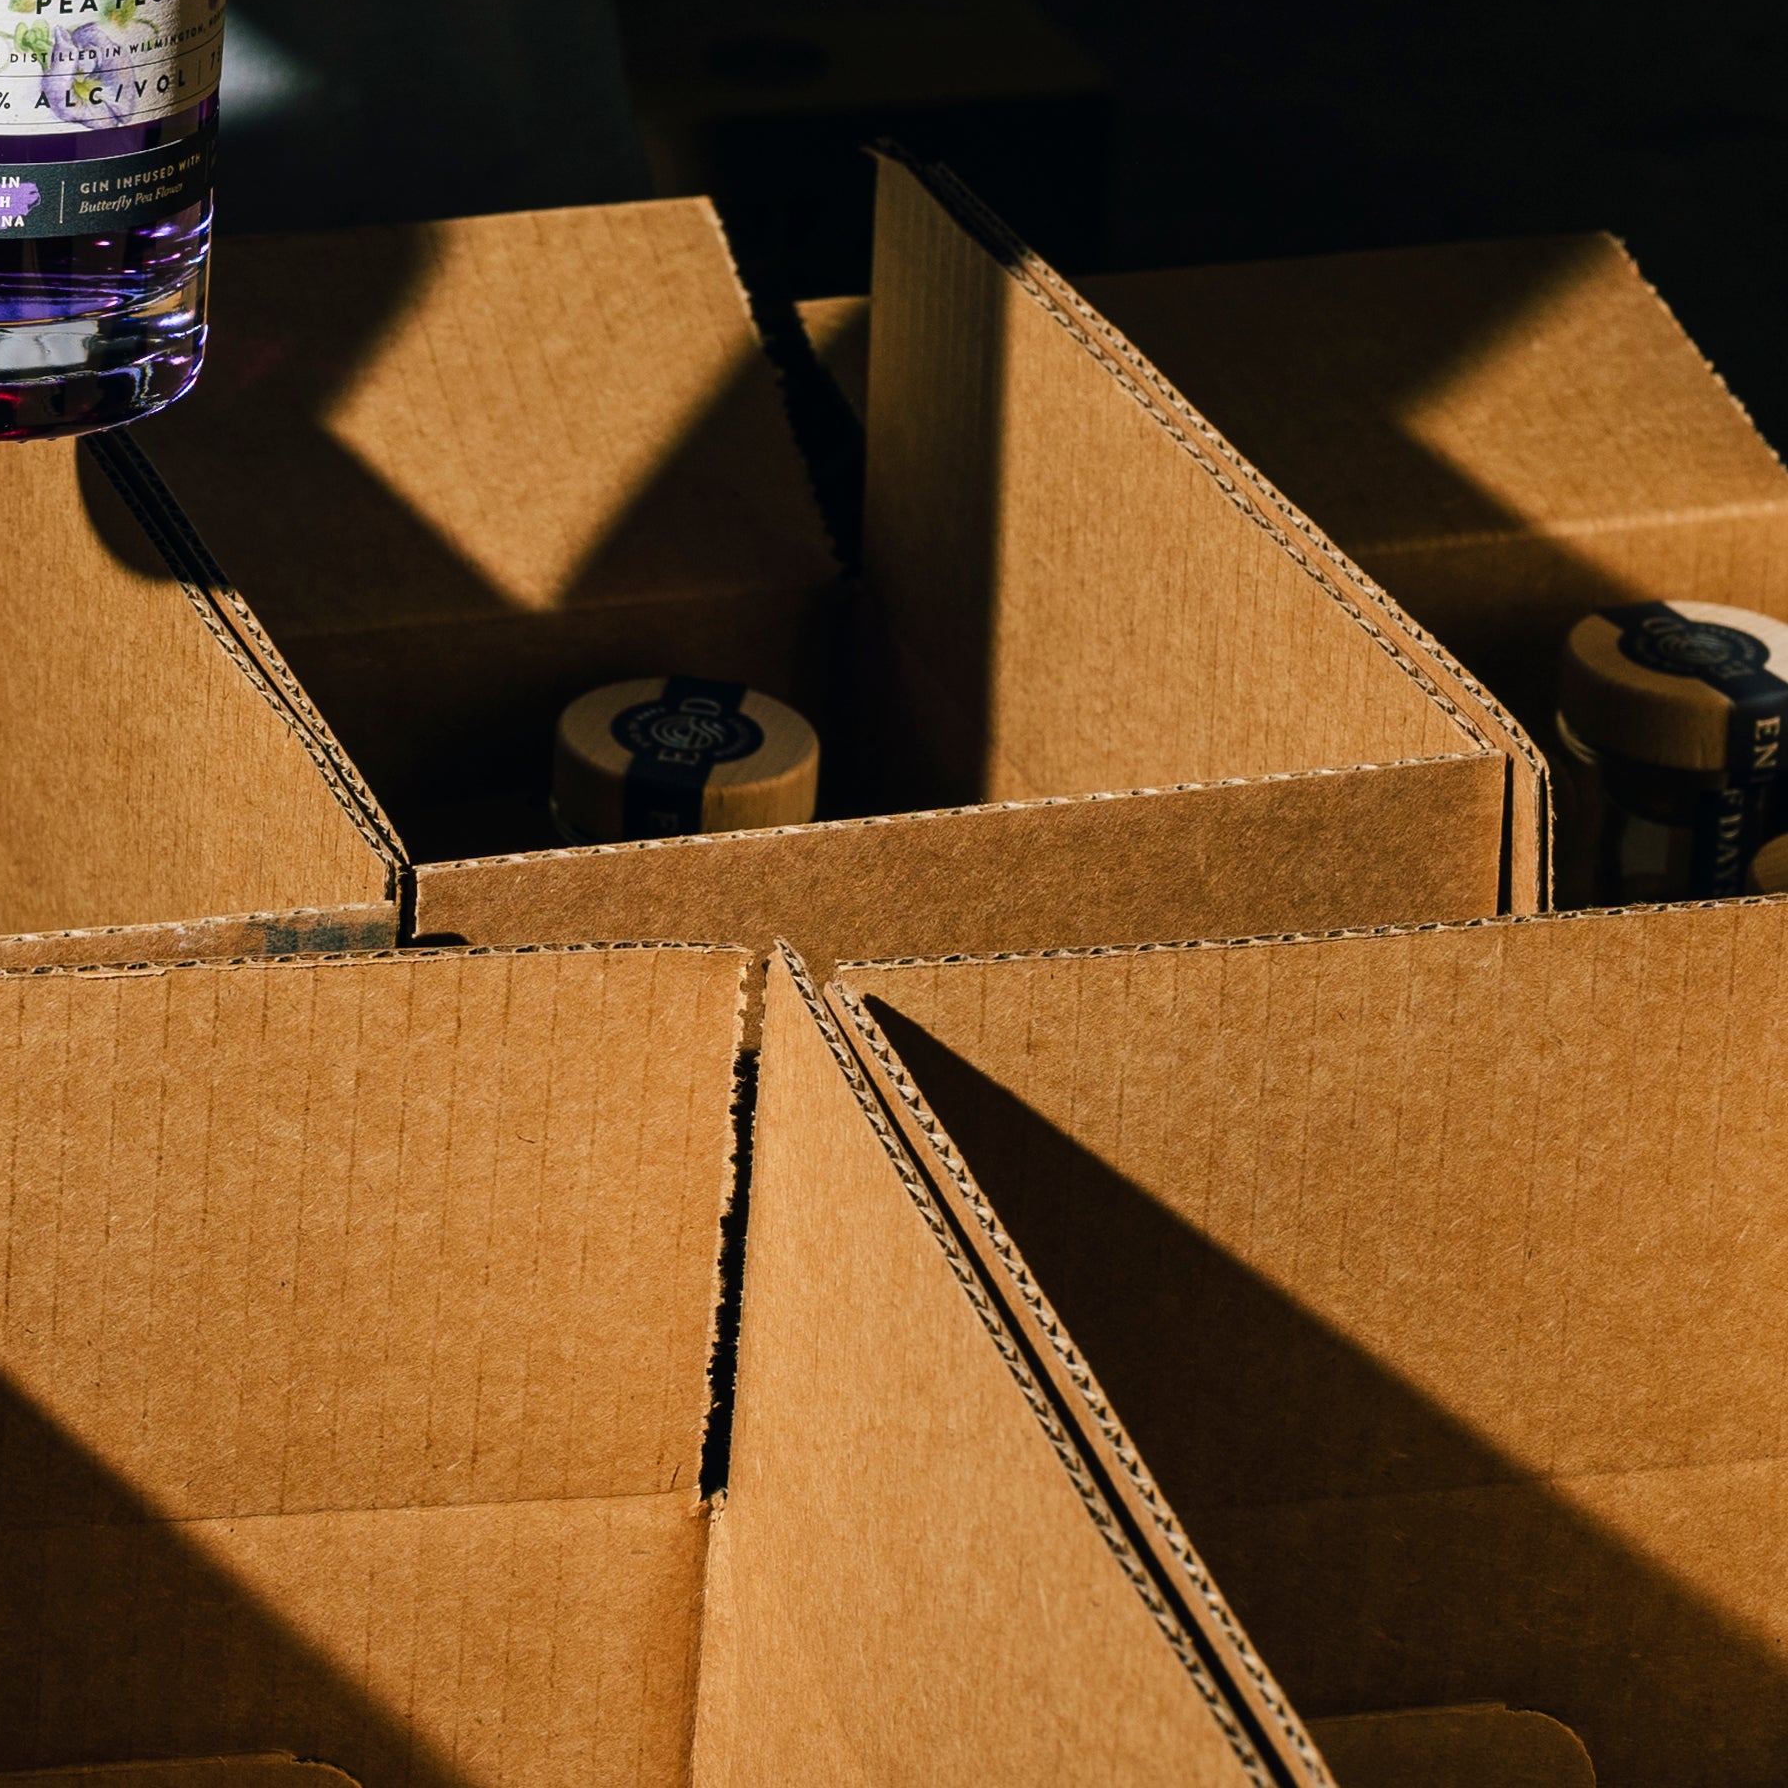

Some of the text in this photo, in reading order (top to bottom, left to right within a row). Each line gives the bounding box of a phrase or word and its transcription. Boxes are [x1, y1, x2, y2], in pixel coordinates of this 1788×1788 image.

[10, 49, 99, 64] DISTILLED
[105, 46, 122, 58] IN
[34, 66, 186, 110] ALC/VOL
[0, 174, 21, 189] IN
[79, 152, 202, 195] GIN INFUSED WITH
[78, 194, 132, 215] Butterfly
[134, 191, 154, 206] Pea
